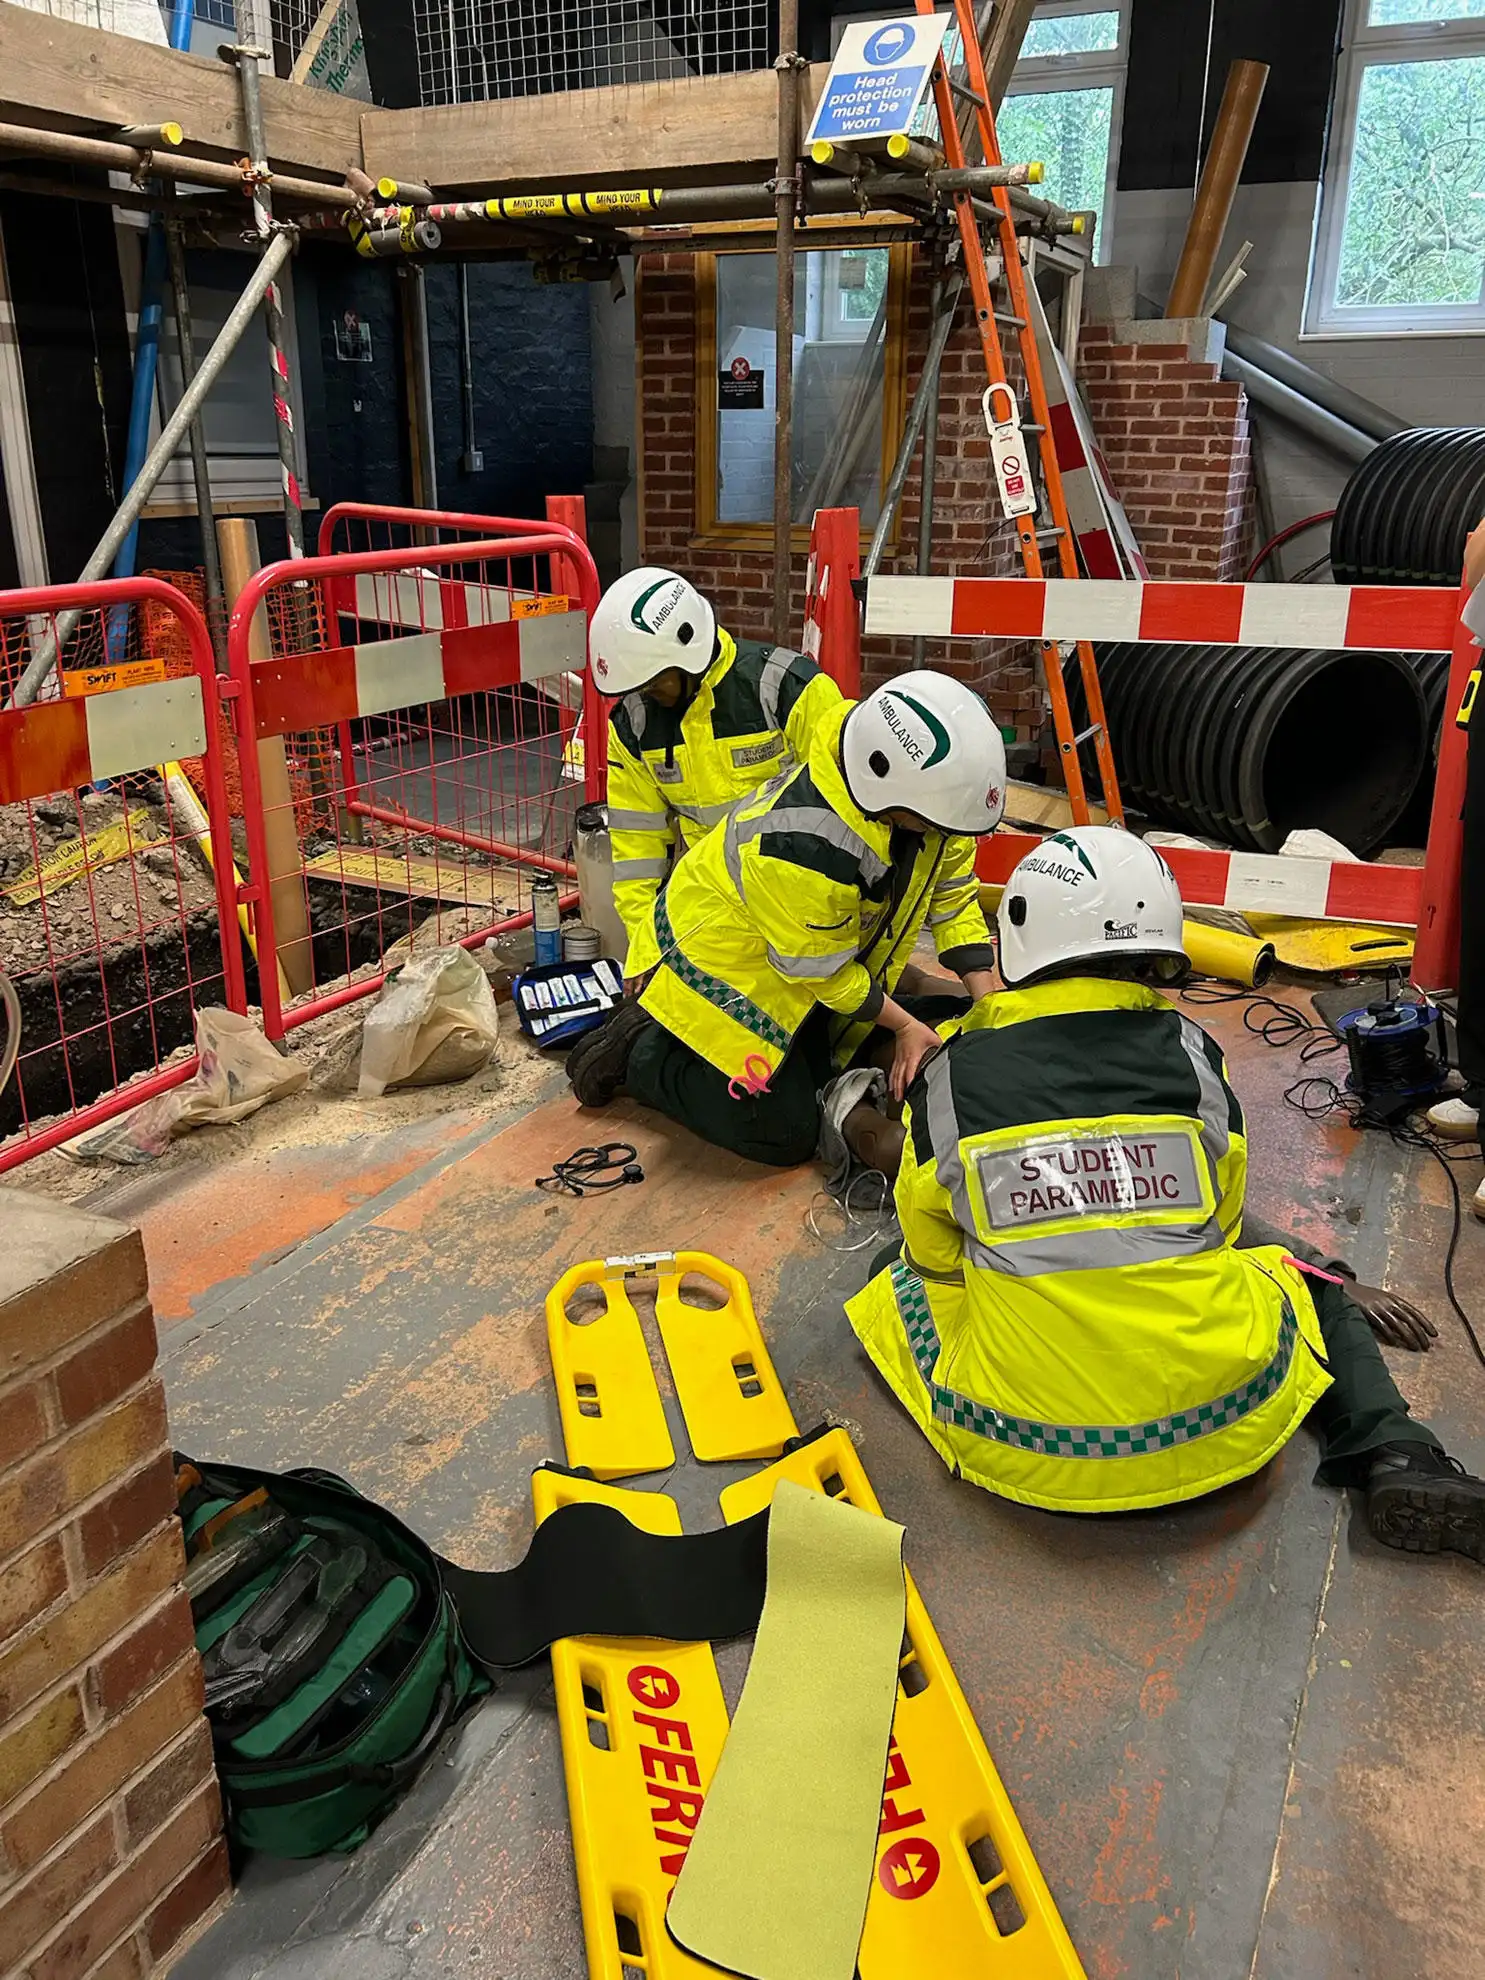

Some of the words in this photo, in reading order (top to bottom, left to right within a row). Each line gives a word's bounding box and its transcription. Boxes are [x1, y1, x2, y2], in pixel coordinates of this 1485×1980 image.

[854, 72, 898, 89] Head
[828, 87, 912, 108] protection
[832, 103, 872, 119] must
[877, 101, 899, 113] be
[842, 117, 880, 130] worn
[512, 199, 533, 208] MIND
[535, 198, 555, 208] YOUR
[596, 193, 617, 204] MIND
[619, 192, 641, 203] YOUR
[651, 582, 687, 630] AMBULANCE
[87, 672, 117, 685] SWIFT
[878, 696, 924, 762] AMBULANCE
[743, 743, 776, 756] STUDENT
[61, 838, 97, 857] CAUTON
[1105, 924, 1138, 939] PACIFIC
[1019, 1143, 1158, 1182] STUDENT
[1010, 1173, 1180, 1217] PARAMEDIC
[632, 1710, 704, 1905] FERN
